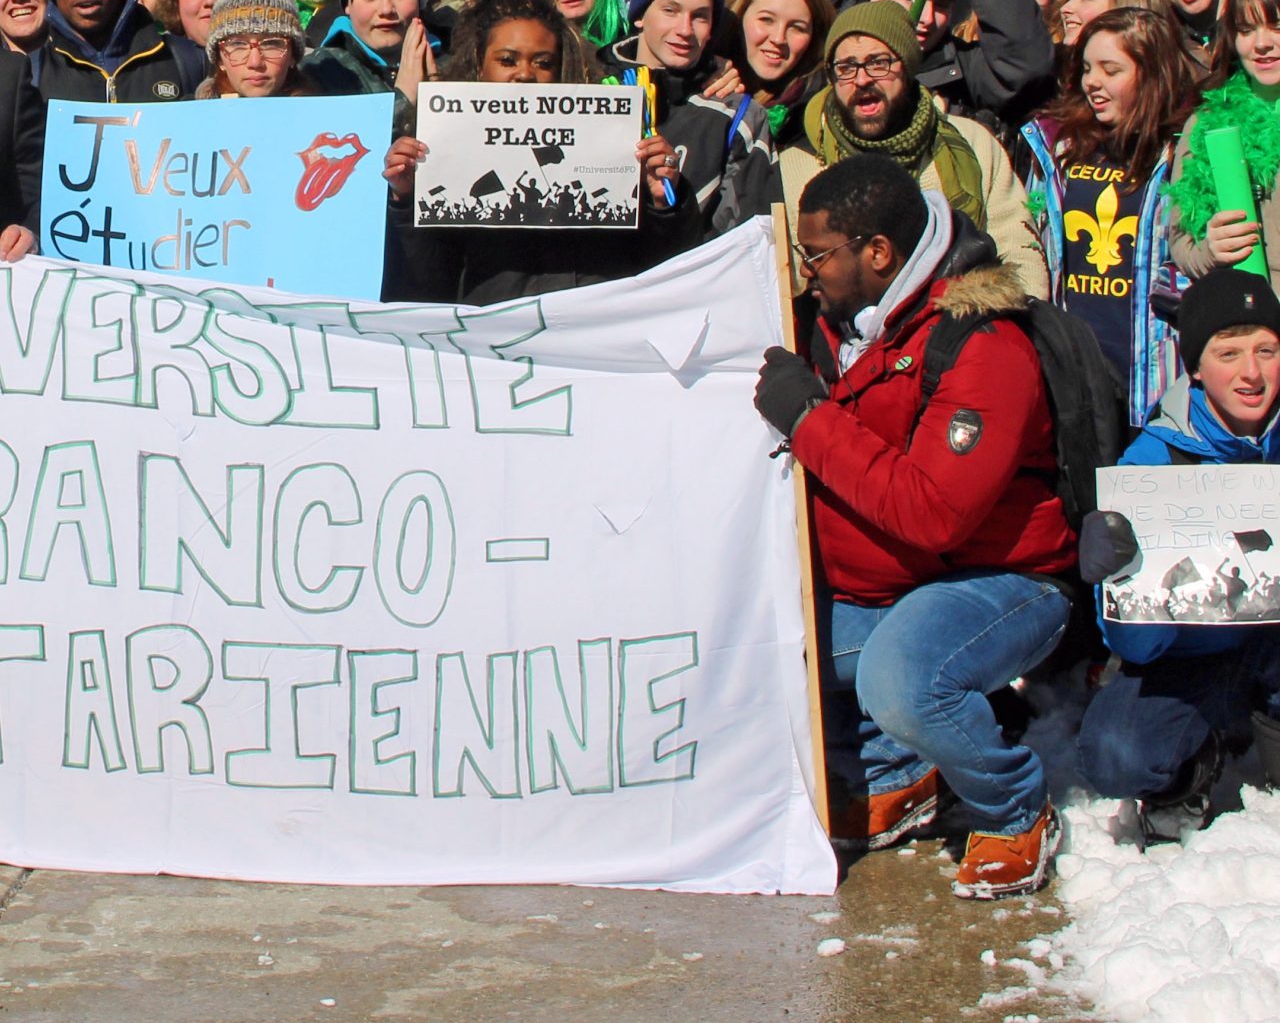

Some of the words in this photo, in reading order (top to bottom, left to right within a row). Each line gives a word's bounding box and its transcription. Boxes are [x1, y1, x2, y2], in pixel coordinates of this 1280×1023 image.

[428, 95, 463, 113] On
[470, 96, 529, 114] veut
[536, 96, 631, 115] NOTRE
[484, 127, 575, 146] PLACE
[50, 197, 251, 271] étudier
[1067, 273, 1133, 297] ATRIO
[1107, 471, 1159, 498] YES
[1164, 503, 1204, 522] DO
[1215, 504, 1280, 520] NEE
